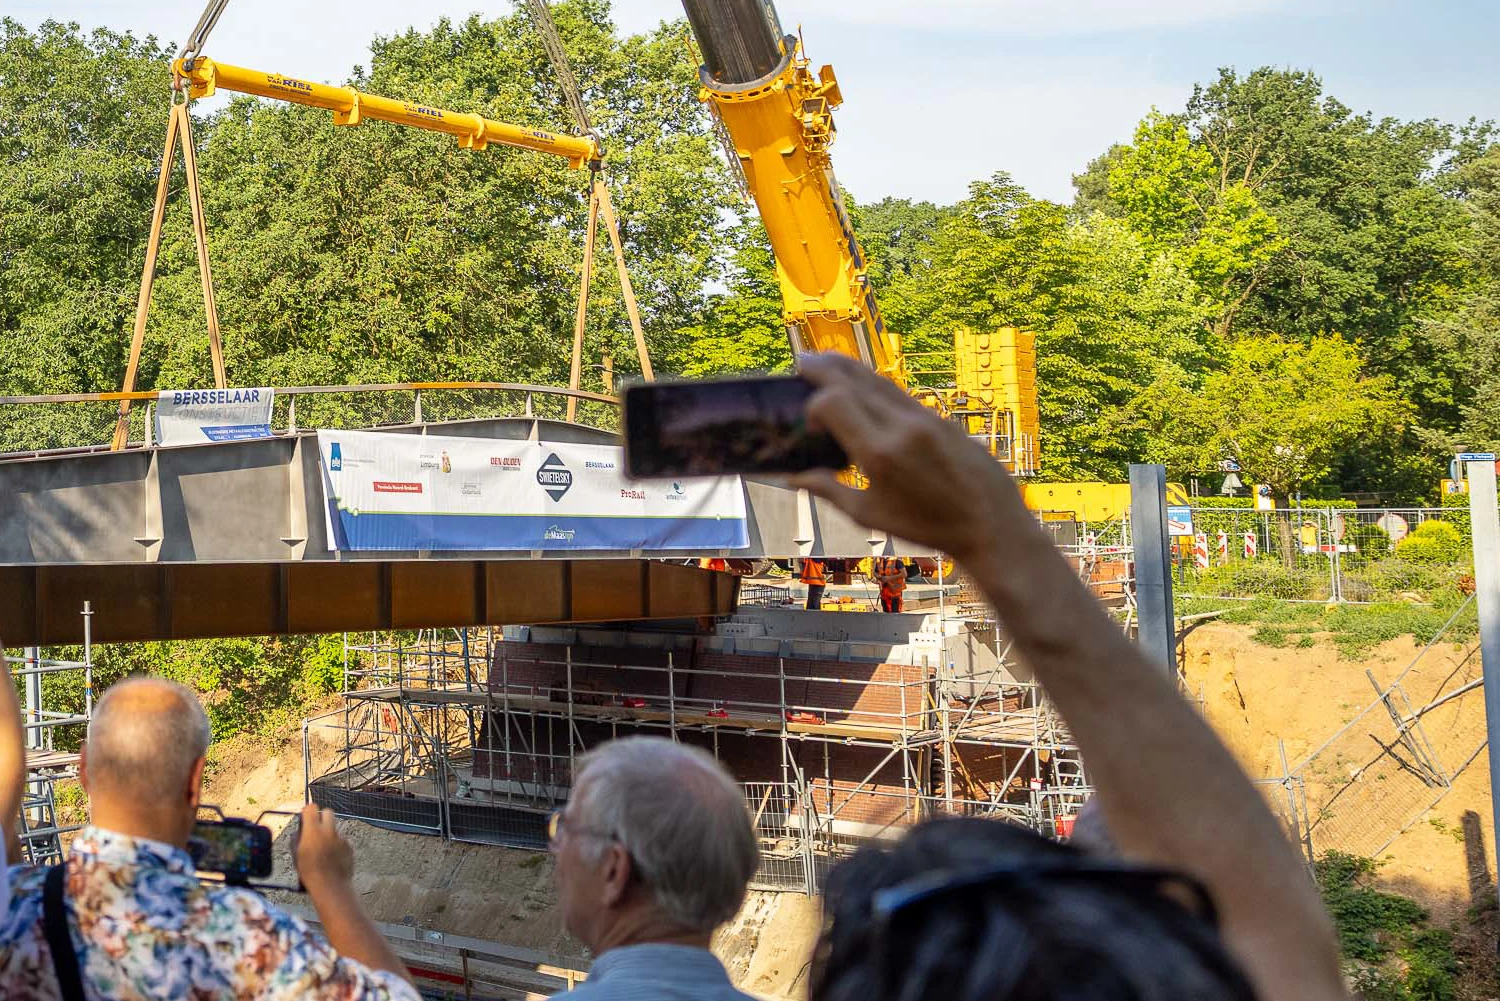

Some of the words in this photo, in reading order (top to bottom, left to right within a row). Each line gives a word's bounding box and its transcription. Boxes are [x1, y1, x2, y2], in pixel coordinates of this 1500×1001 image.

[282, 79, 313, 91] RIEL
[417, 107, 444, 118] RIEL
[173, 389, 260, 405] BERSSELAAR
[539, 471, 570, 483] SWIETELSKY
[620, 489, 645, 500] ProRail
